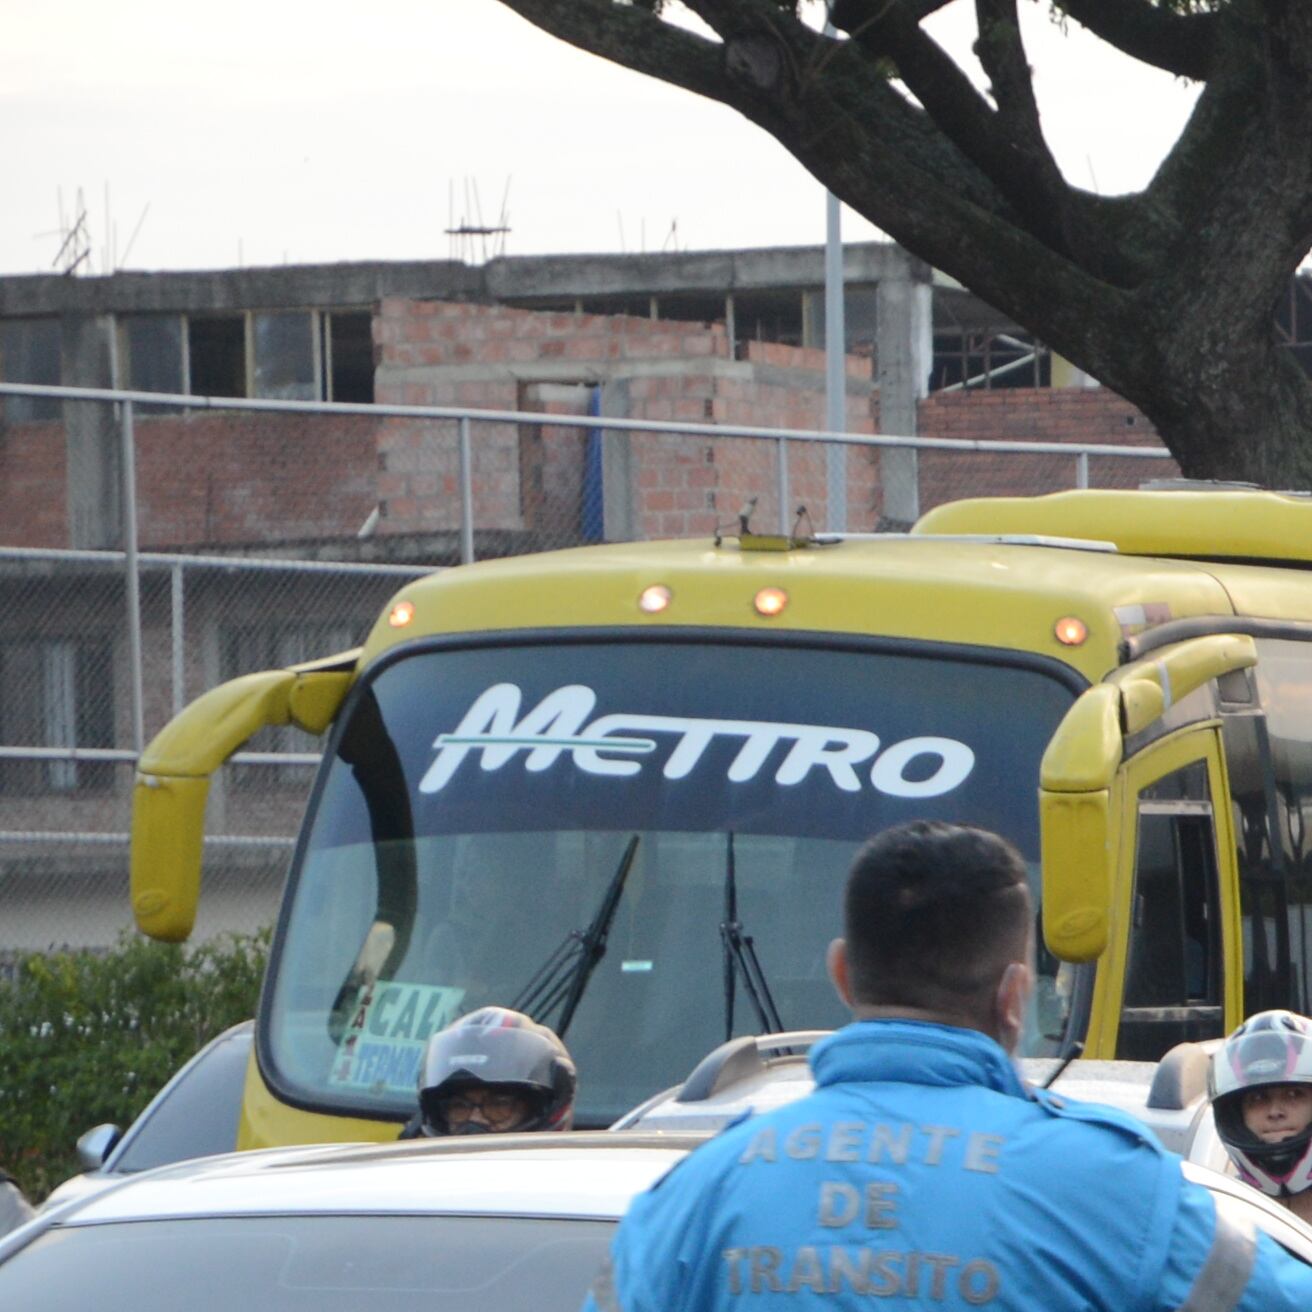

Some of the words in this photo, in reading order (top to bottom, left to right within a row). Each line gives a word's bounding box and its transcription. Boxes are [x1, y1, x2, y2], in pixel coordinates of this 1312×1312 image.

[419, 683, 975, 797] METTRO
[739, 1121, 1003, 1174] AGENTE
[817, 1181, 900, 1230] DE
[722, 1245, 1000, 1306] TRANSITO
